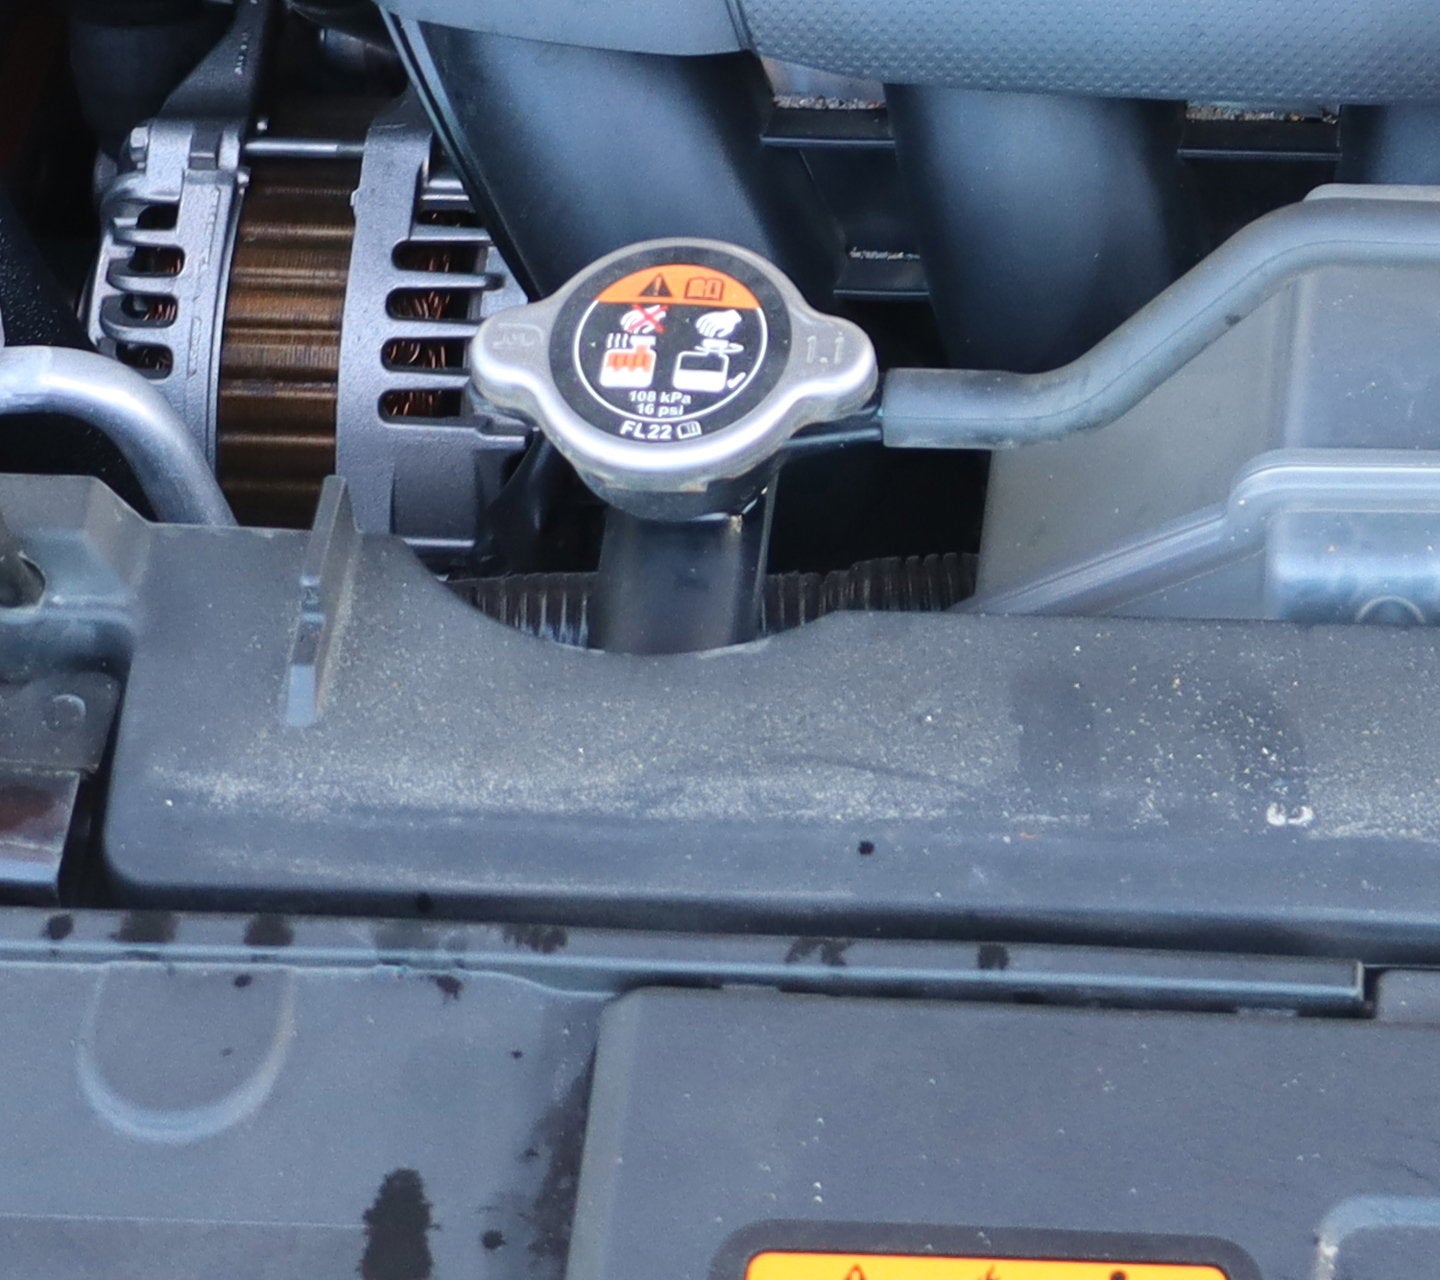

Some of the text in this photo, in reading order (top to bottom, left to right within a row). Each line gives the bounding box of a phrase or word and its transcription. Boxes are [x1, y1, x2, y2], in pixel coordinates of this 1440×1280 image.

[629, 390, 691, 405] 108 kPa
[638, 403, 684, 418] 16 psi
[620, 420, 673, 439] FL22
